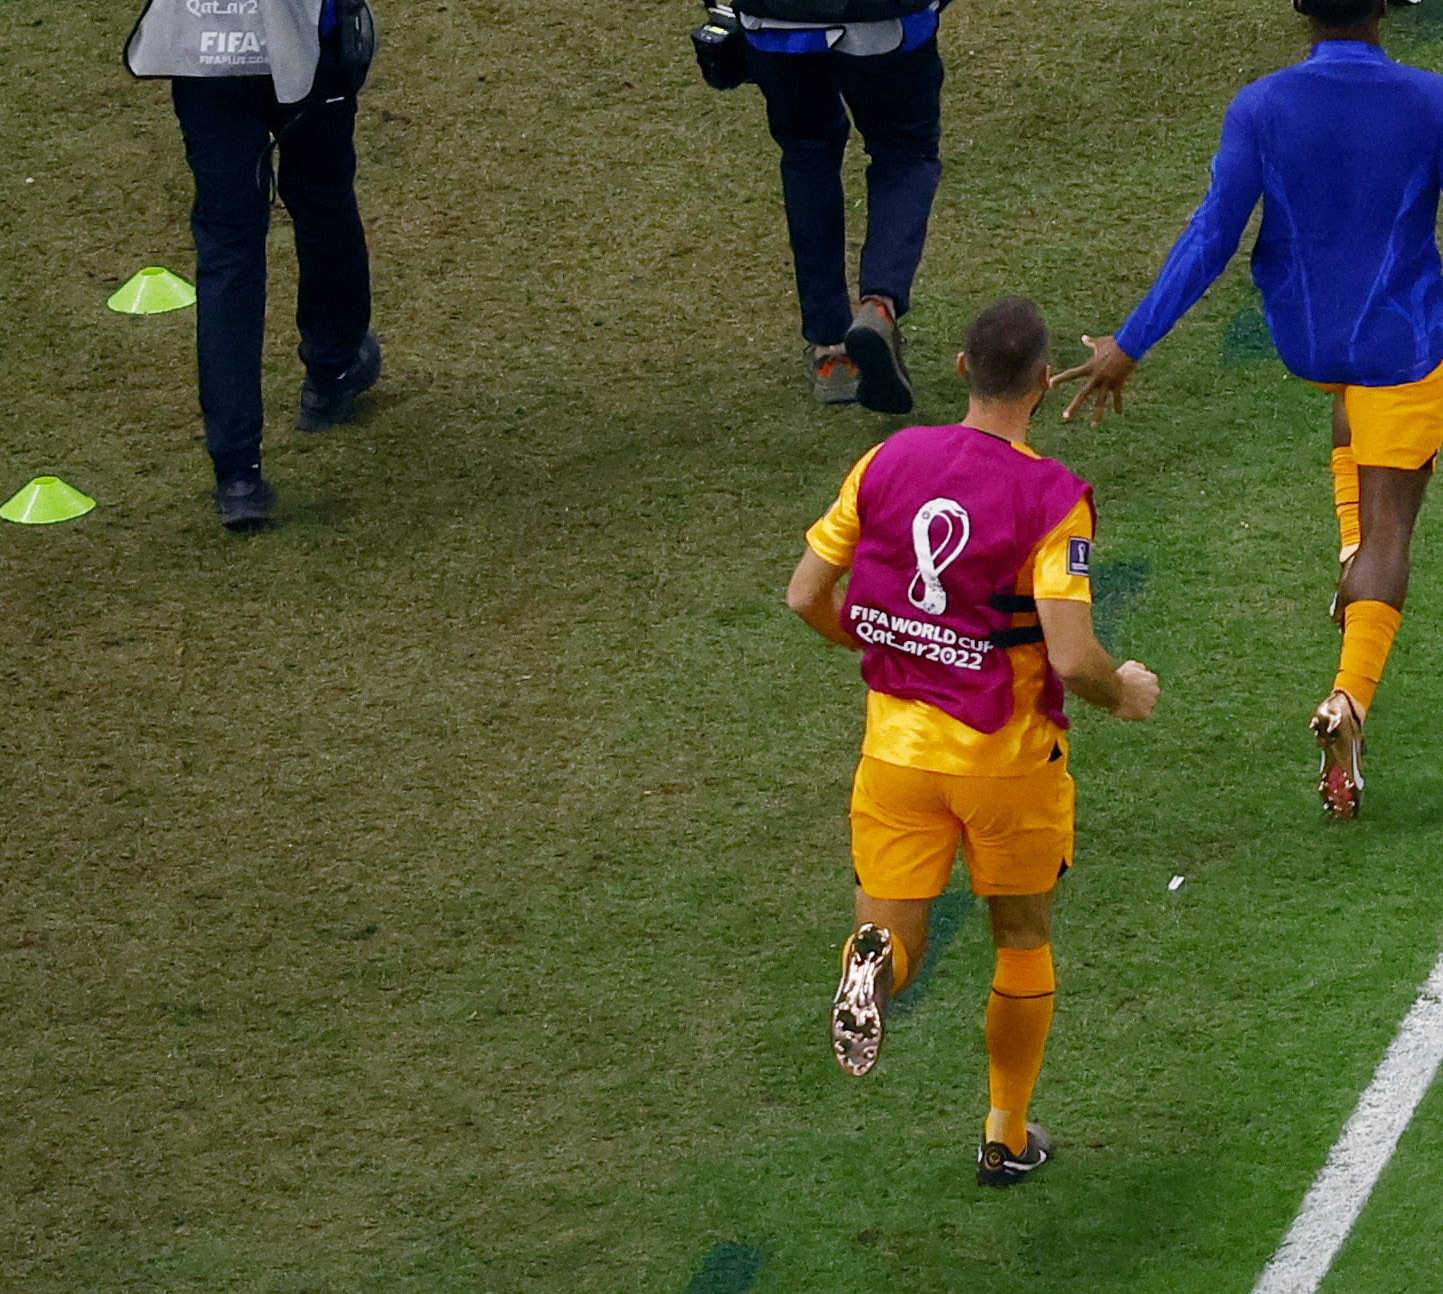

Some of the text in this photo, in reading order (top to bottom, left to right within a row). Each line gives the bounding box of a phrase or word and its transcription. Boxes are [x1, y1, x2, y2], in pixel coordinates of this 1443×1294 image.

[850, 605, 890, 628] FIFA
[886, 613, 955, 647] WORLD
[855, 621, 984, 671] Qatar2022
